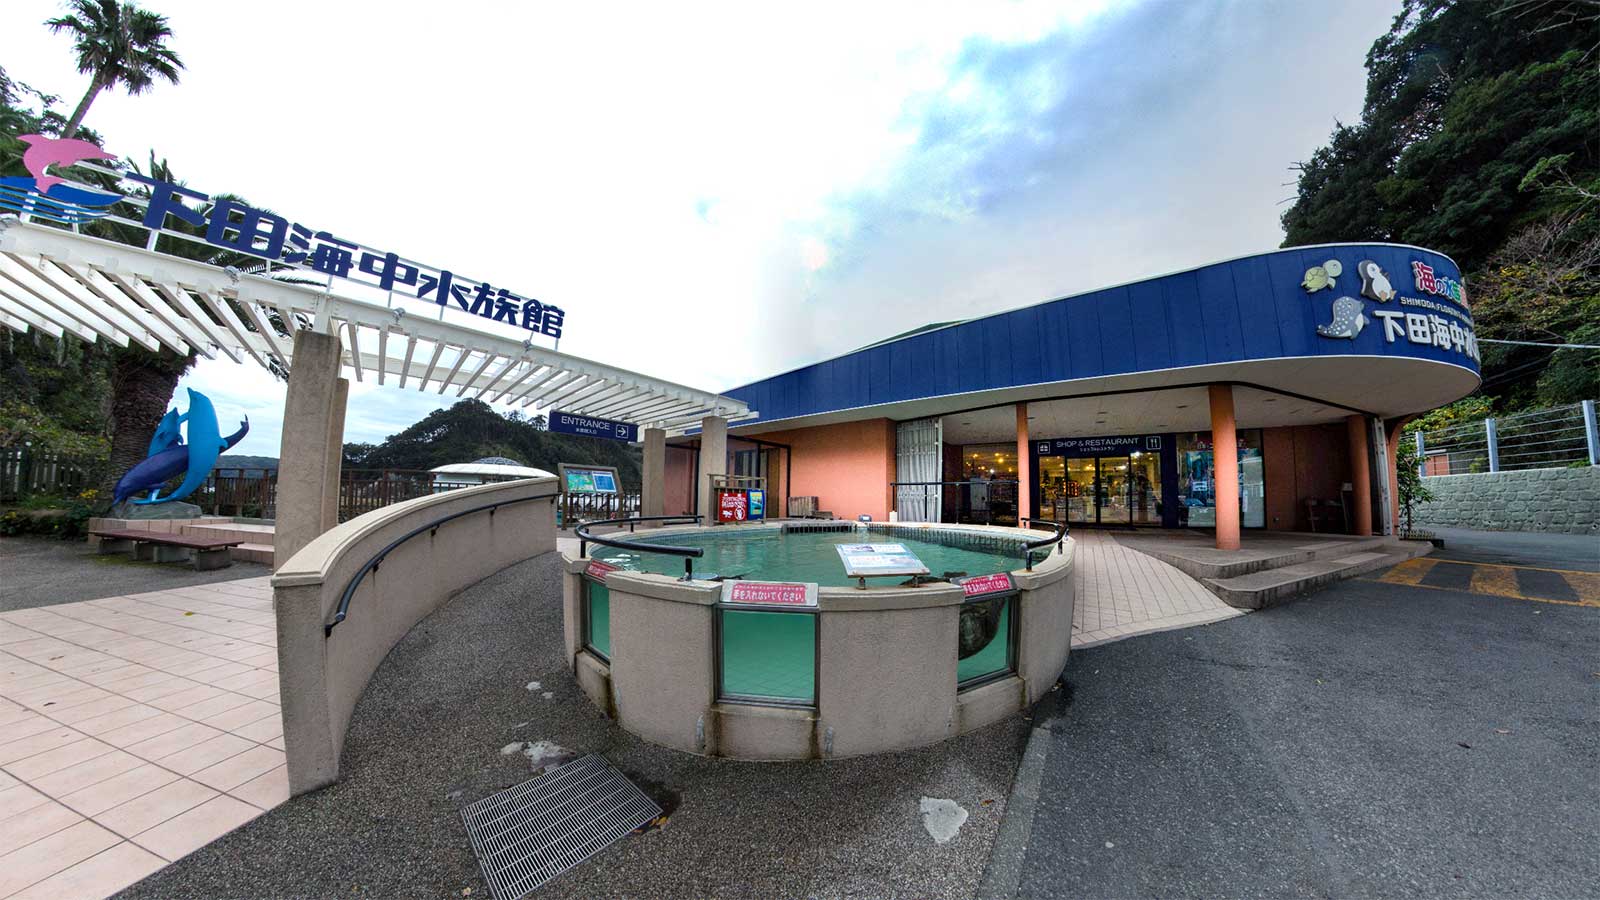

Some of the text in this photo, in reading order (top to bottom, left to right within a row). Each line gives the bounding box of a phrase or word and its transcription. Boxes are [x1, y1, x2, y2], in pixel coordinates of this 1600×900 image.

[125, 171, 566, 340] 下田海中水族館
[561, 415, 611, 431] ENTRANCE
[1056, 440, 1078, 448] SHOP
[1085, 437, 1139, 447] RESTAURANT
